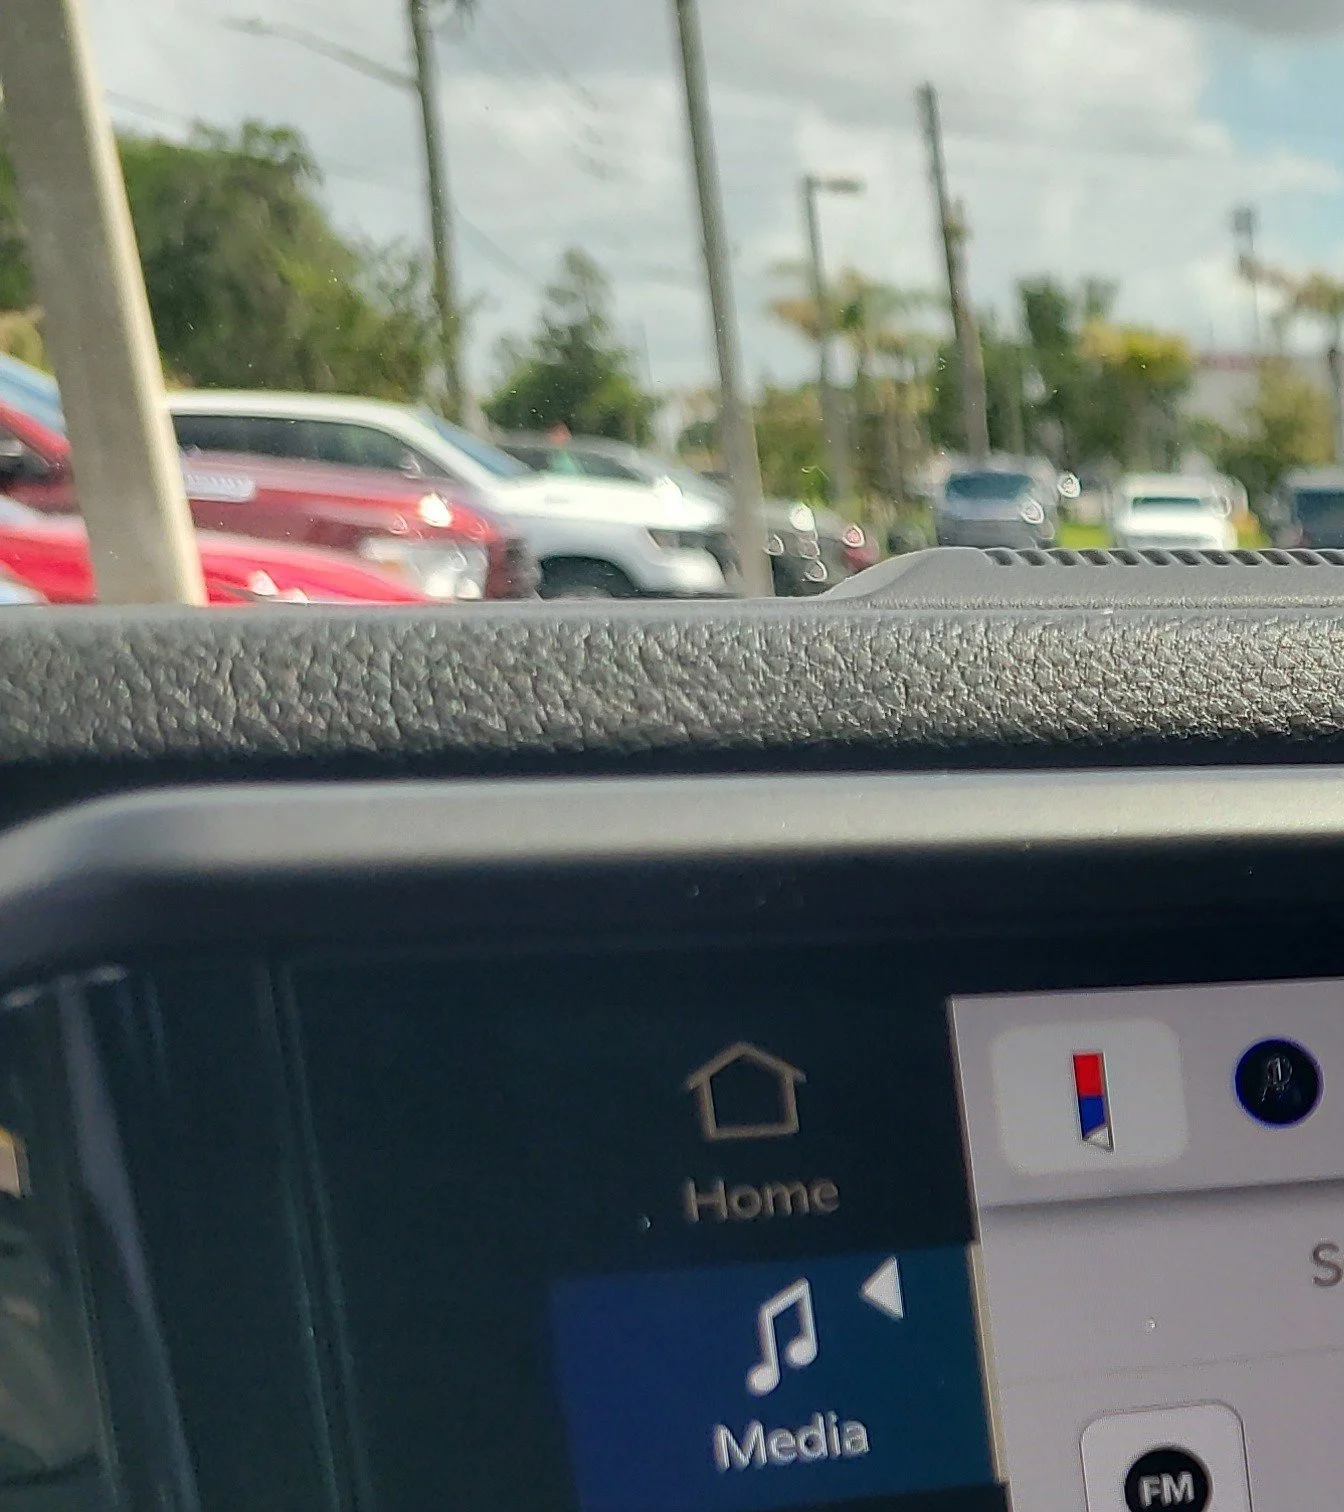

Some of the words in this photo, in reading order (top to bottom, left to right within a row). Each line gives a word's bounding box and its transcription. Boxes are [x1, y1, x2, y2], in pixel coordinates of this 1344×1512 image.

[684, 1178, 841, 1224] Home
[713, 1412, 871, 1471] Media
[1138, 1470, 1196, 1510] FM
